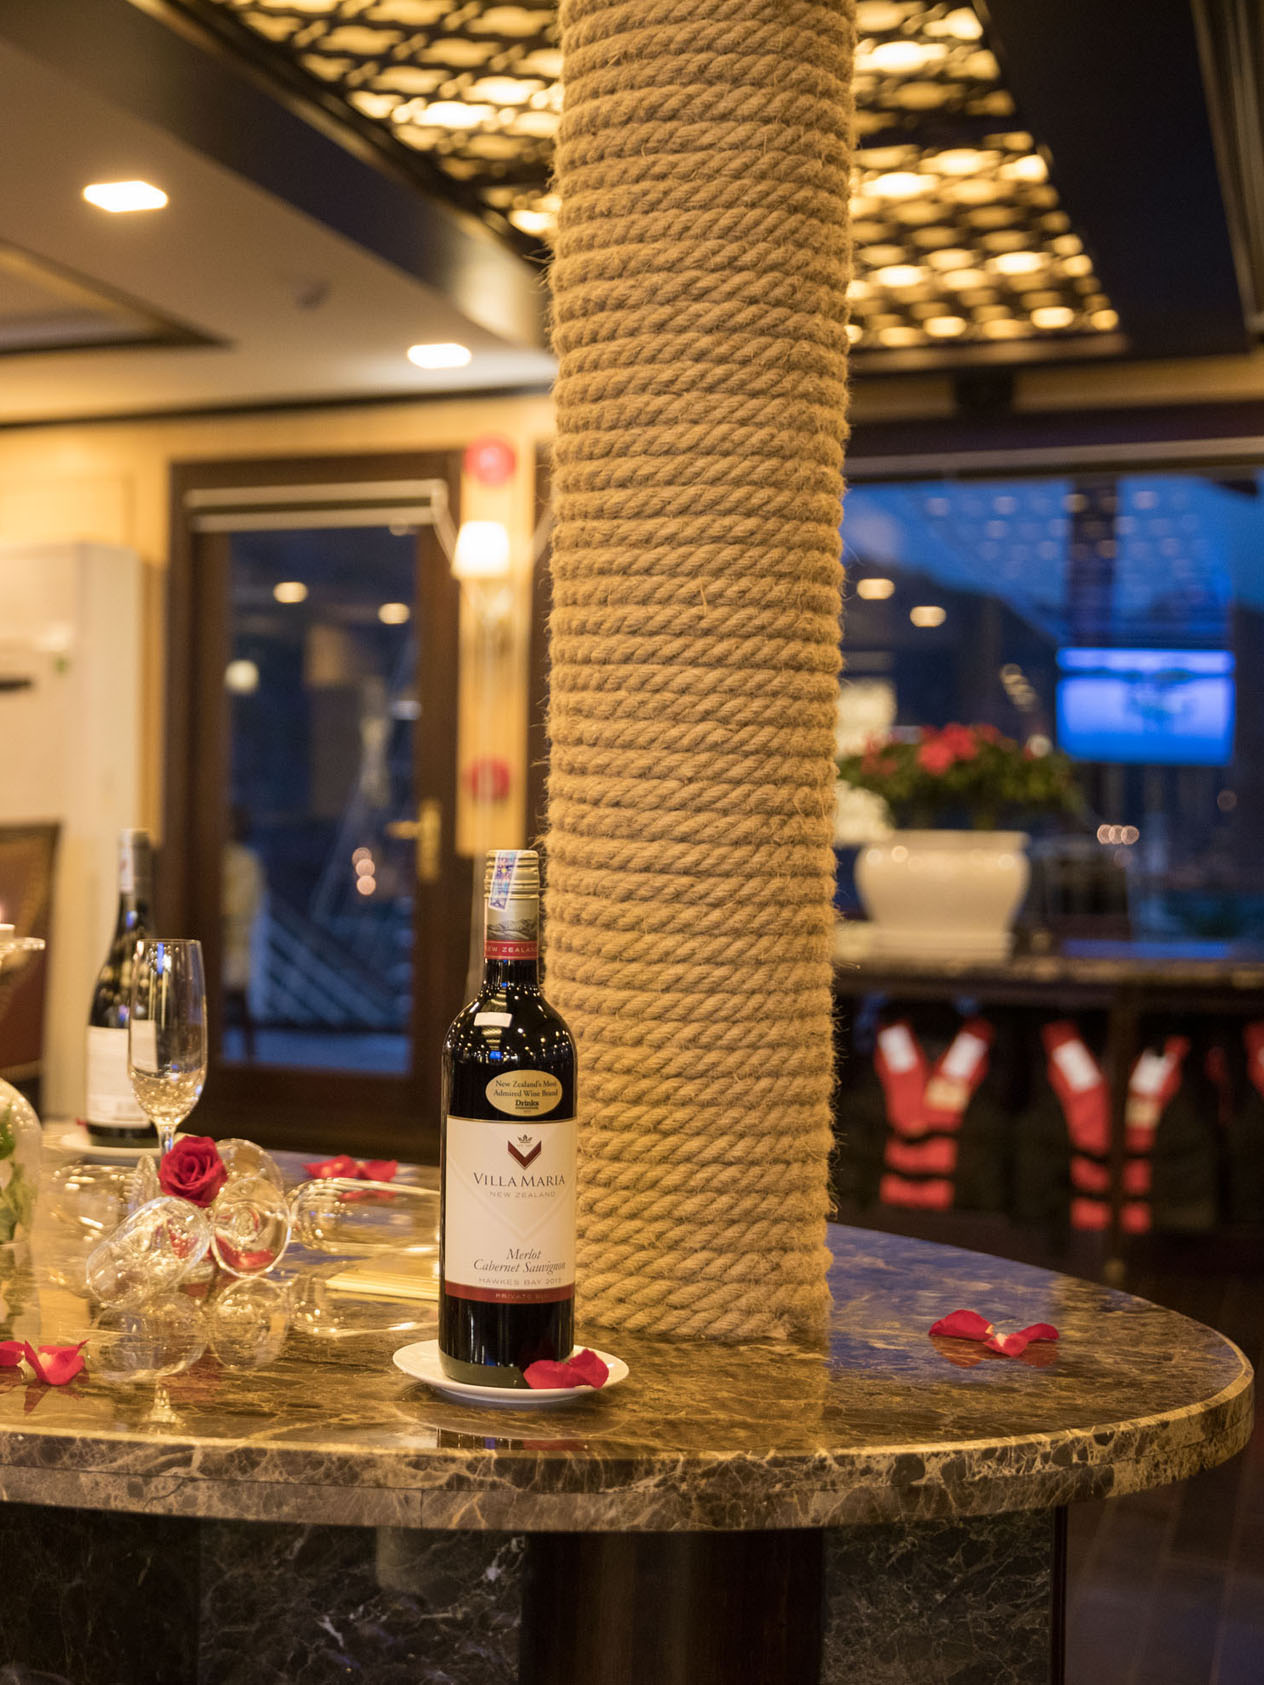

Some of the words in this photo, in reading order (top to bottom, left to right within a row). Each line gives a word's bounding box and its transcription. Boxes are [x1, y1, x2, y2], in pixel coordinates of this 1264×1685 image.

[495, 1080, 510, 1088] New
[512, 1080, 542, 1088] Zealand's
[515, 1099, 539, 1107] Drinks
[473, 1172, 517, 1187] VILLA
[520, 1174, 566, 1187] MARIA
[506, 1248, 542, 1260] Merlot
[473, 1259, 520, 1273] Cabernet
[522, 1260, 566, 1275] Sauvignon
